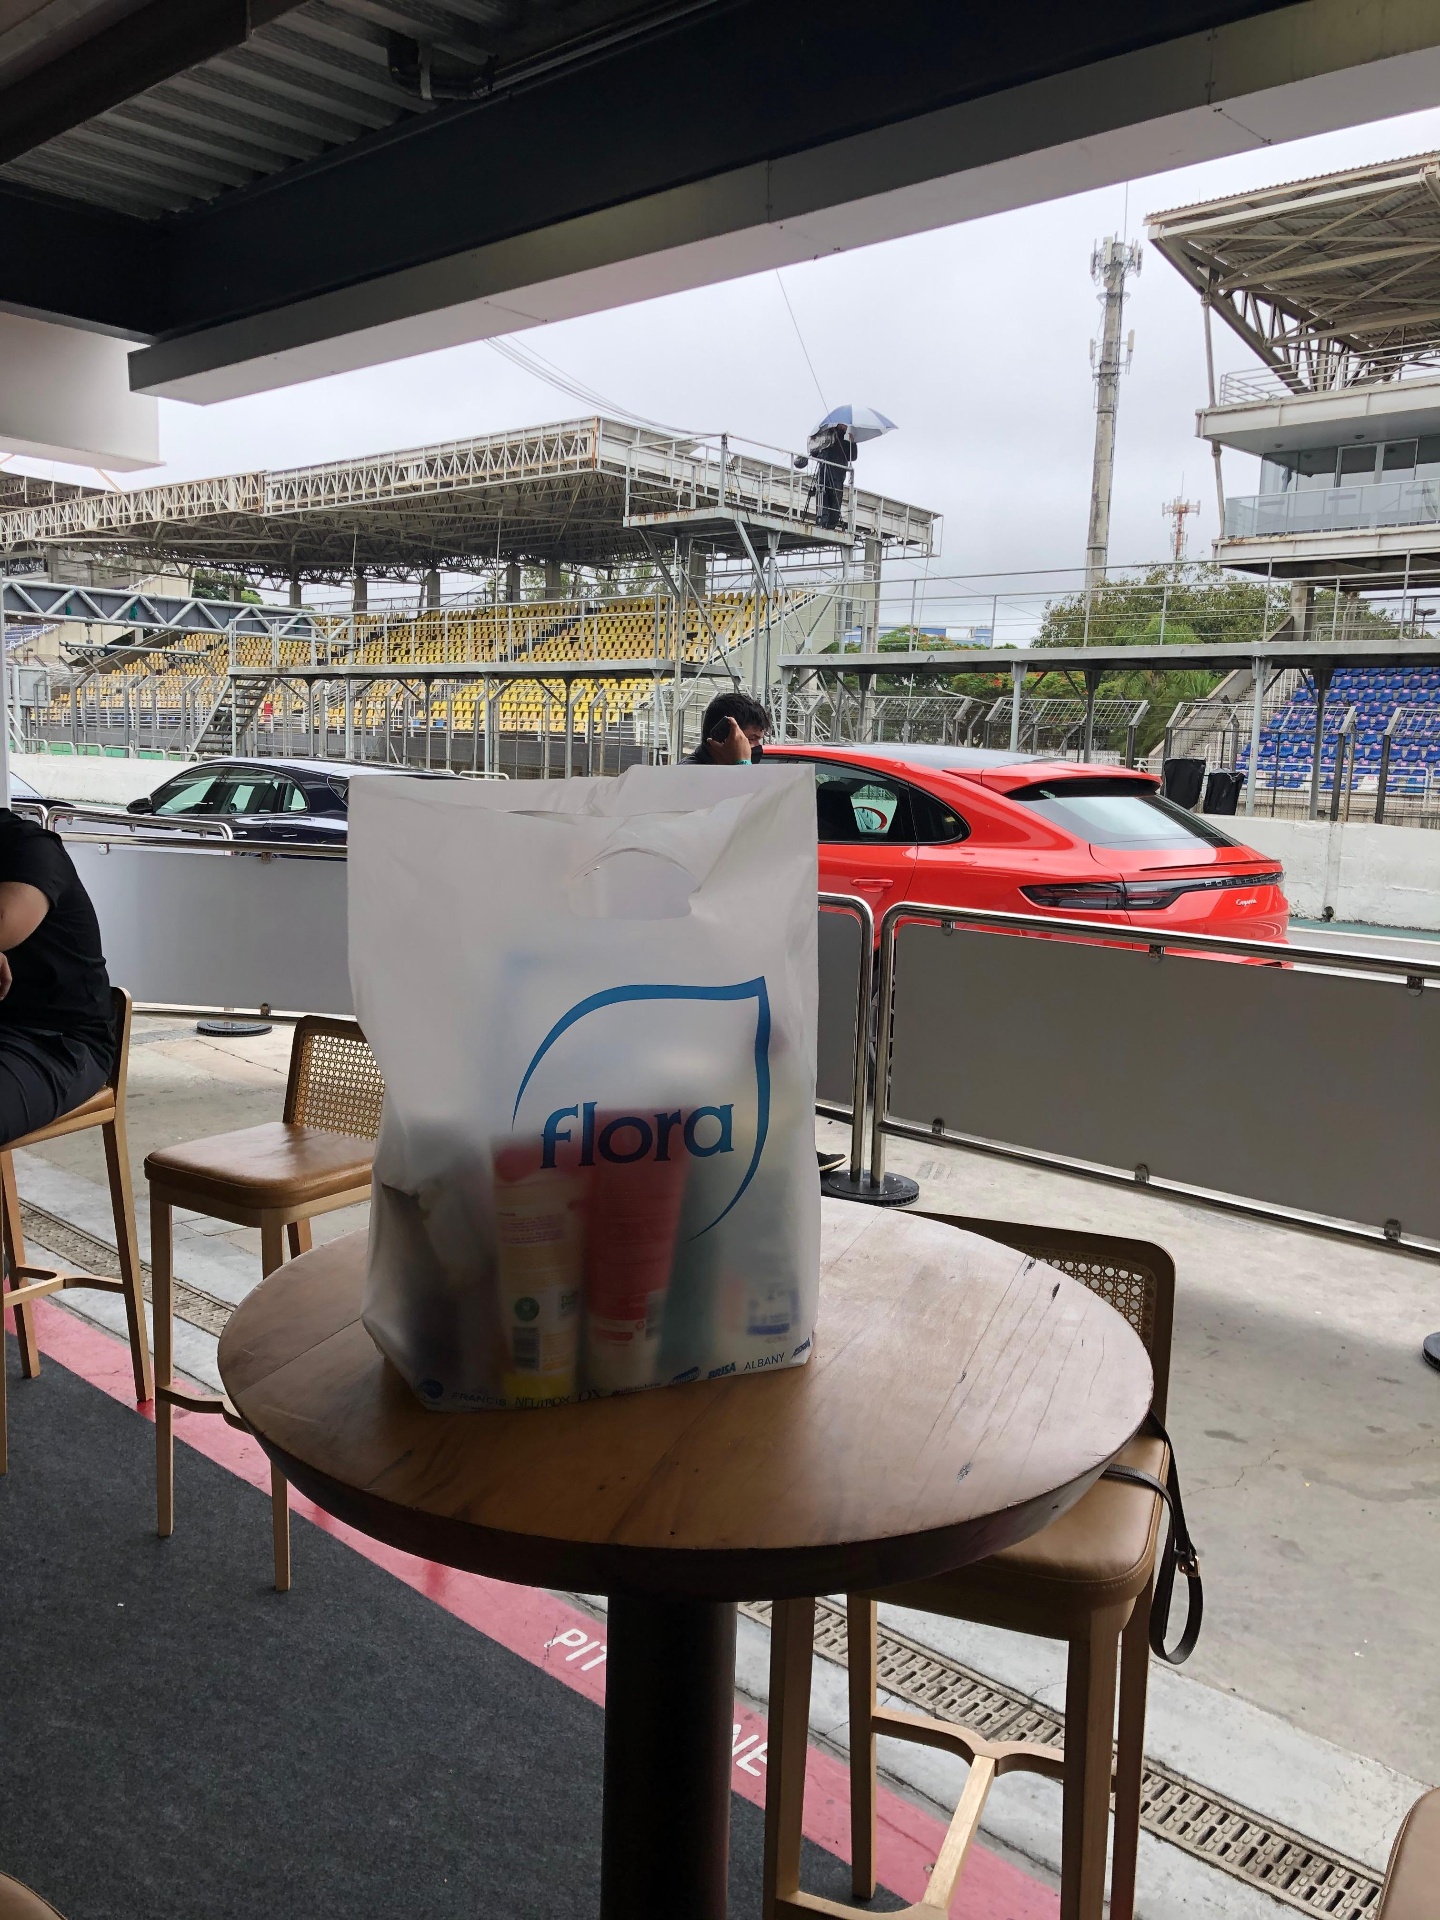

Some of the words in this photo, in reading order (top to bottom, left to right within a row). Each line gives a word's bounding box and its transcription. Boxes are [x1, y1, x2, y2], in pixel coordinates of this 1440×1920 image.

[539, 1101, 735, 1169] flora
[450, 1391, 508, 1408] FRANCIS
[708, 1361, 737, 1379] BRISA
[743, 1352, 786, 1372] ALBANY
[544, 1628, 607, 1671] PIT
